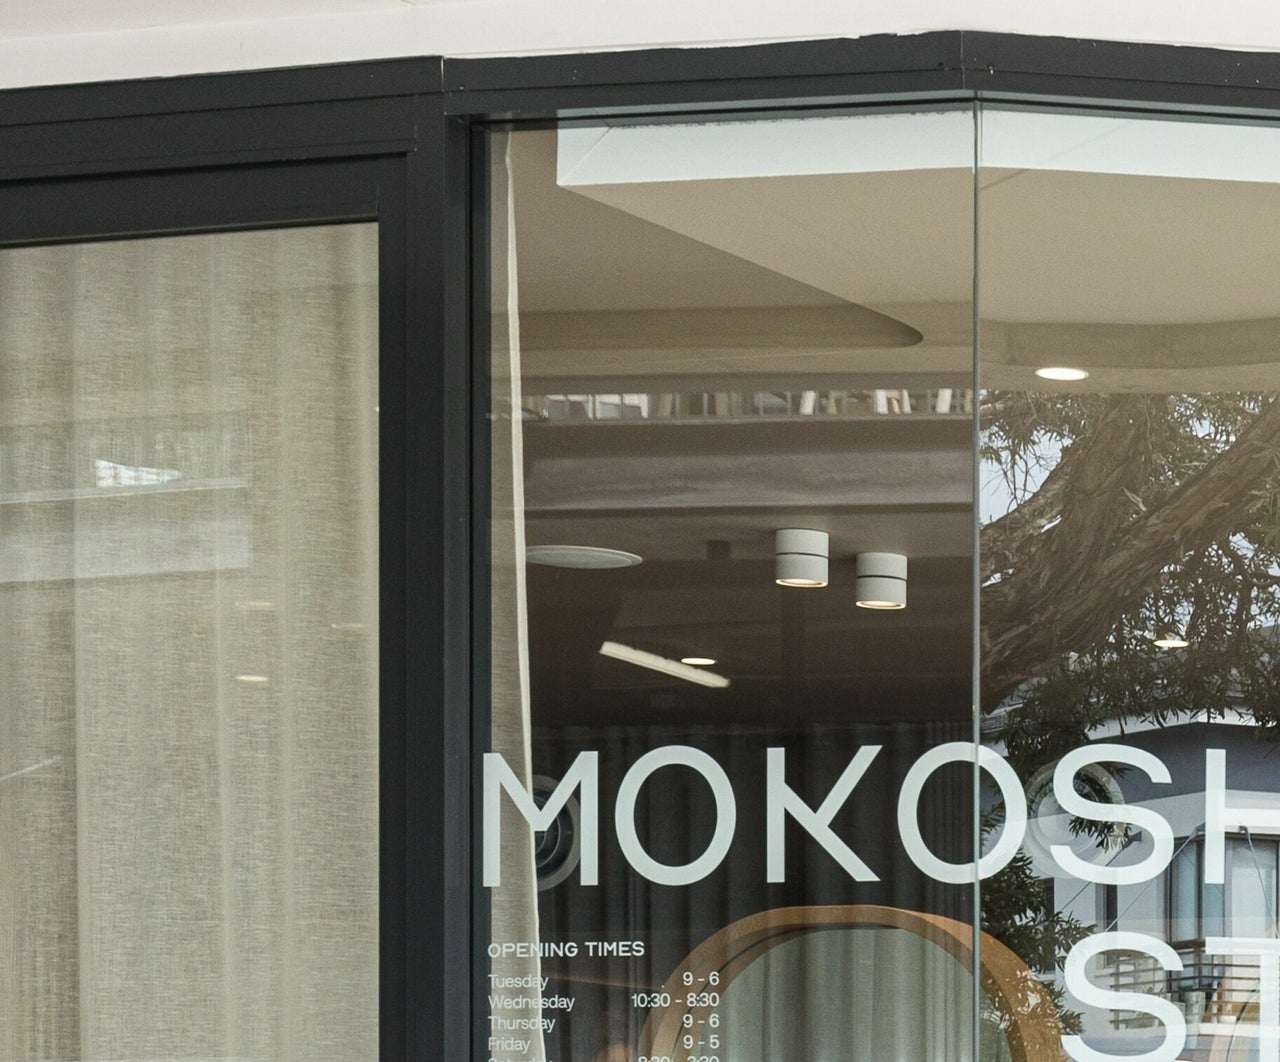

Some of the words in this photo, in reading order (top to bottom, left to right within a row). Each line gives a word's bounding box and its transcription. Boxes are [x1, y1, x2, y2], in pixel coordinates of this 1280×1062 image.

[488, 942, 578, 958] OPENING
[585, 941, 645, 957] TIMES
[488, 974, 549, 990] Tuesday
[683, 972, 693, 986] 9
[709, 971, 720, 985] 6
[488, 995, 575, 1012] Wednesday
[631, 993, 671, 1008] 10:30
[686, 993, 720, 1007] 8:30
[488, 1016, 556, 1033] Thursday
[683, 1014, 693, 1028] 9
[709, 1014, 720, 1028] 6
[488, 1037, 530, 1053] Friday
[683, 1035, 693, 1049] 9
[709, 1035, 720, 1049] 5
